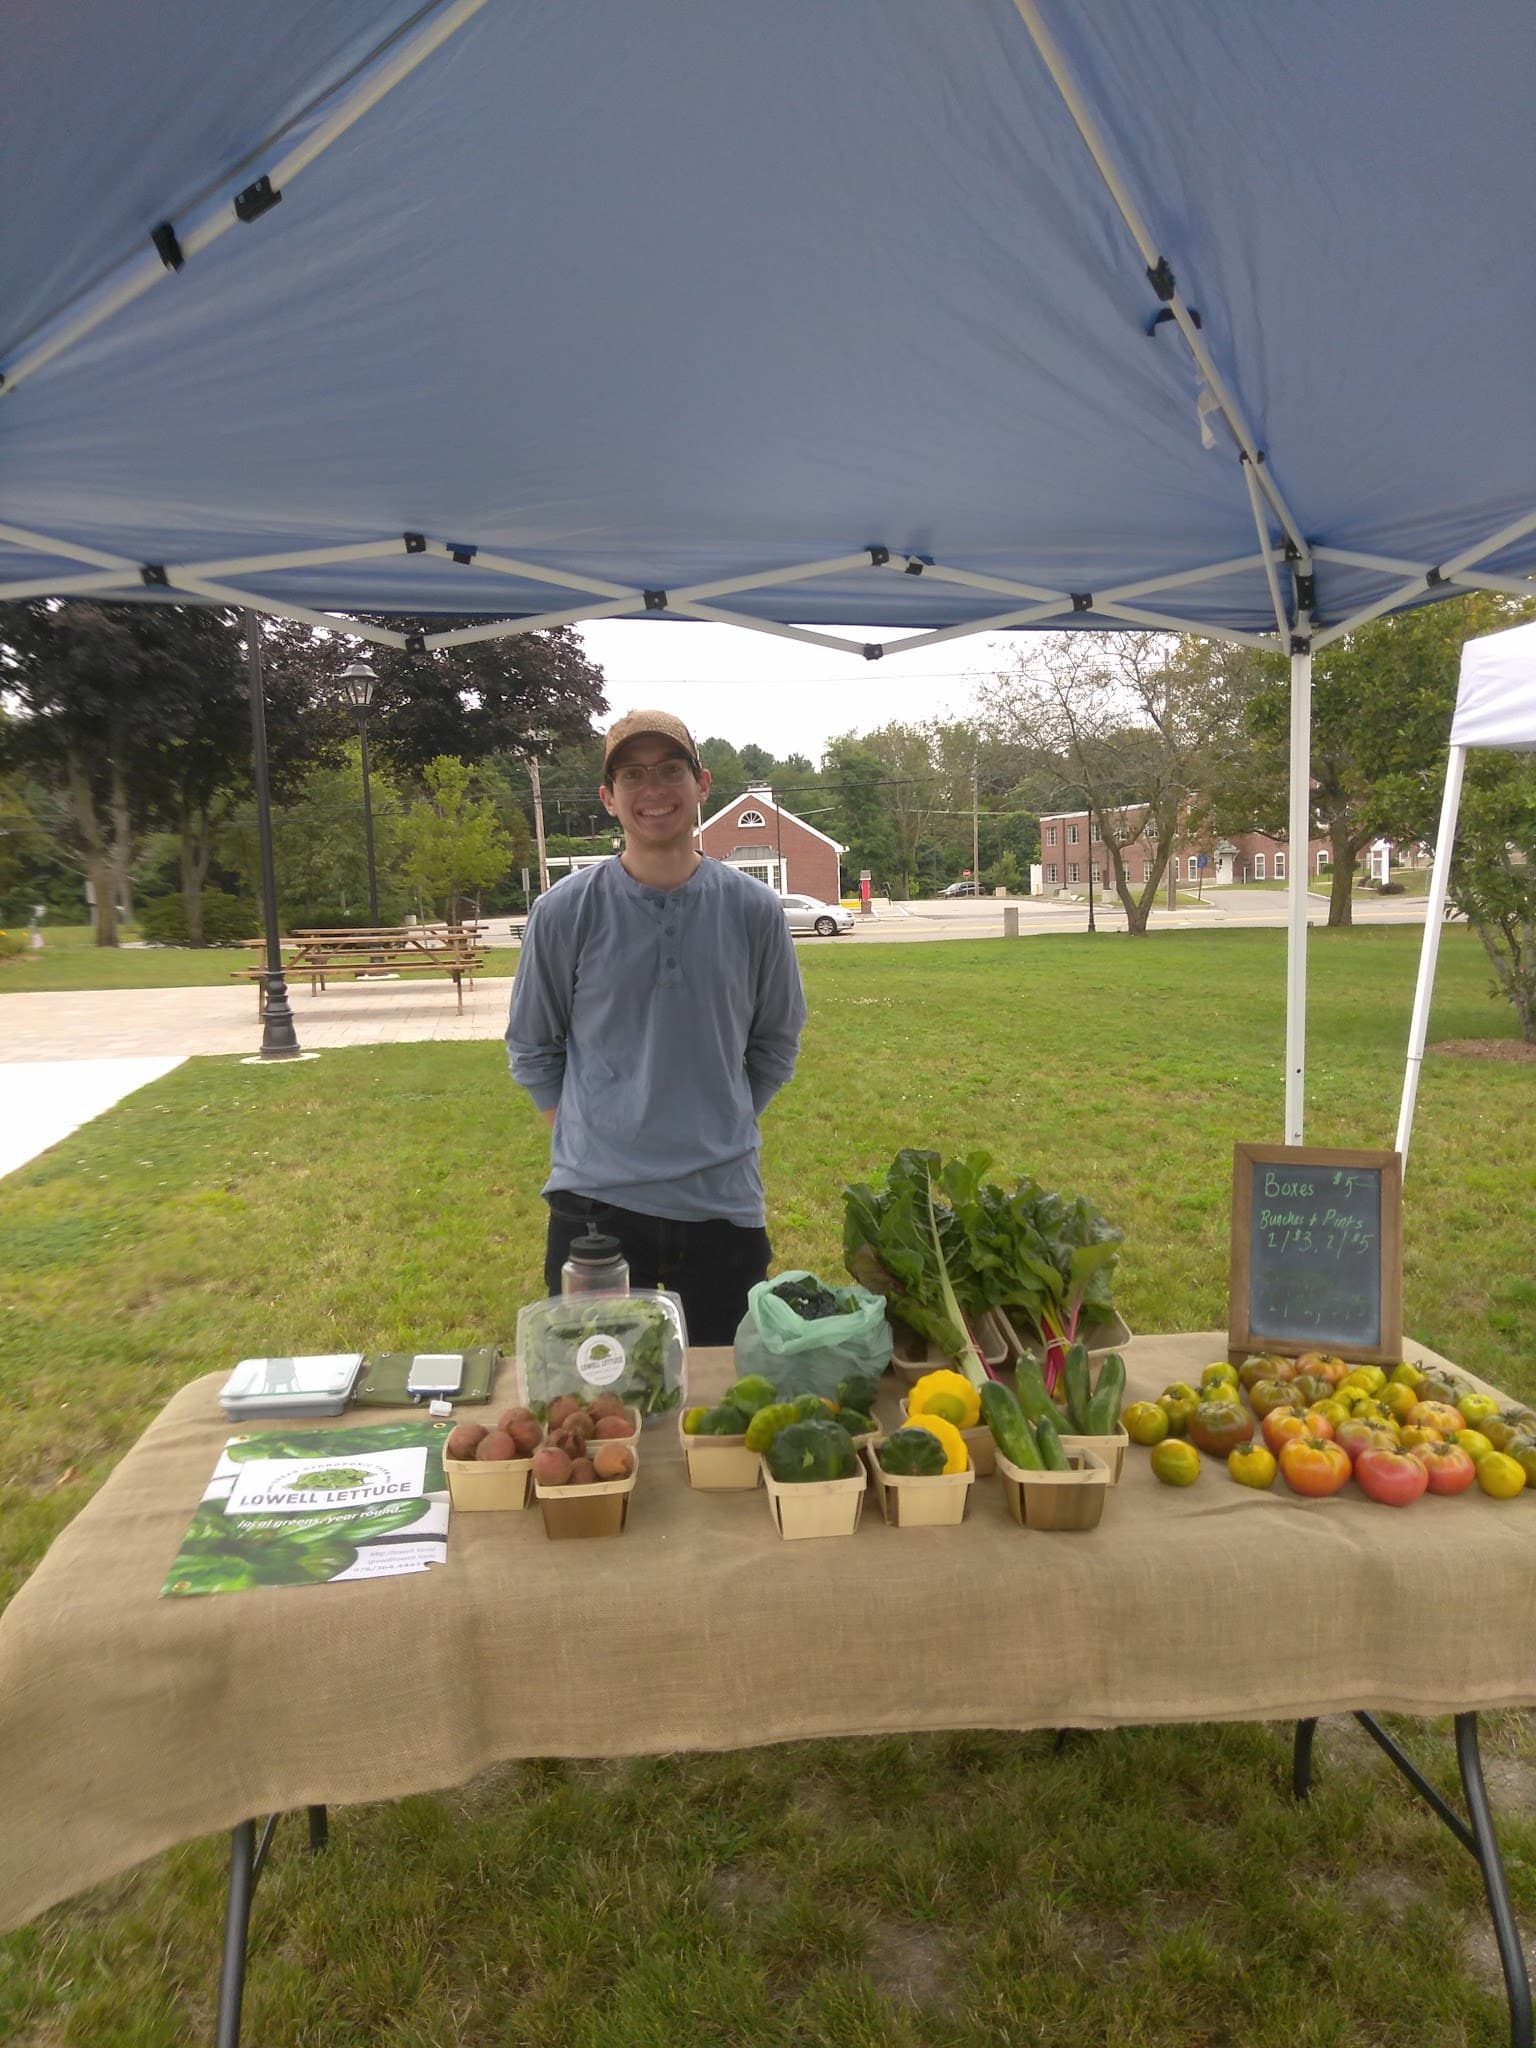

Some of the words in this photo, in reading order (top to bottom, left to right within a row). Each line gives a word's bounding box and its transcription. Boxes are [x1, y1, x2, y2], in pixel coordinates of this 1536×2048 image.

[1264, 1172, 1314, 1197] Boxes
[239, 1492, 318, 1506] LOWELL
[326, 1482, 412, 1502] LETTUCE
[236, 1519, 273, 1529] local
[325, 1512, 359, 1524] year
